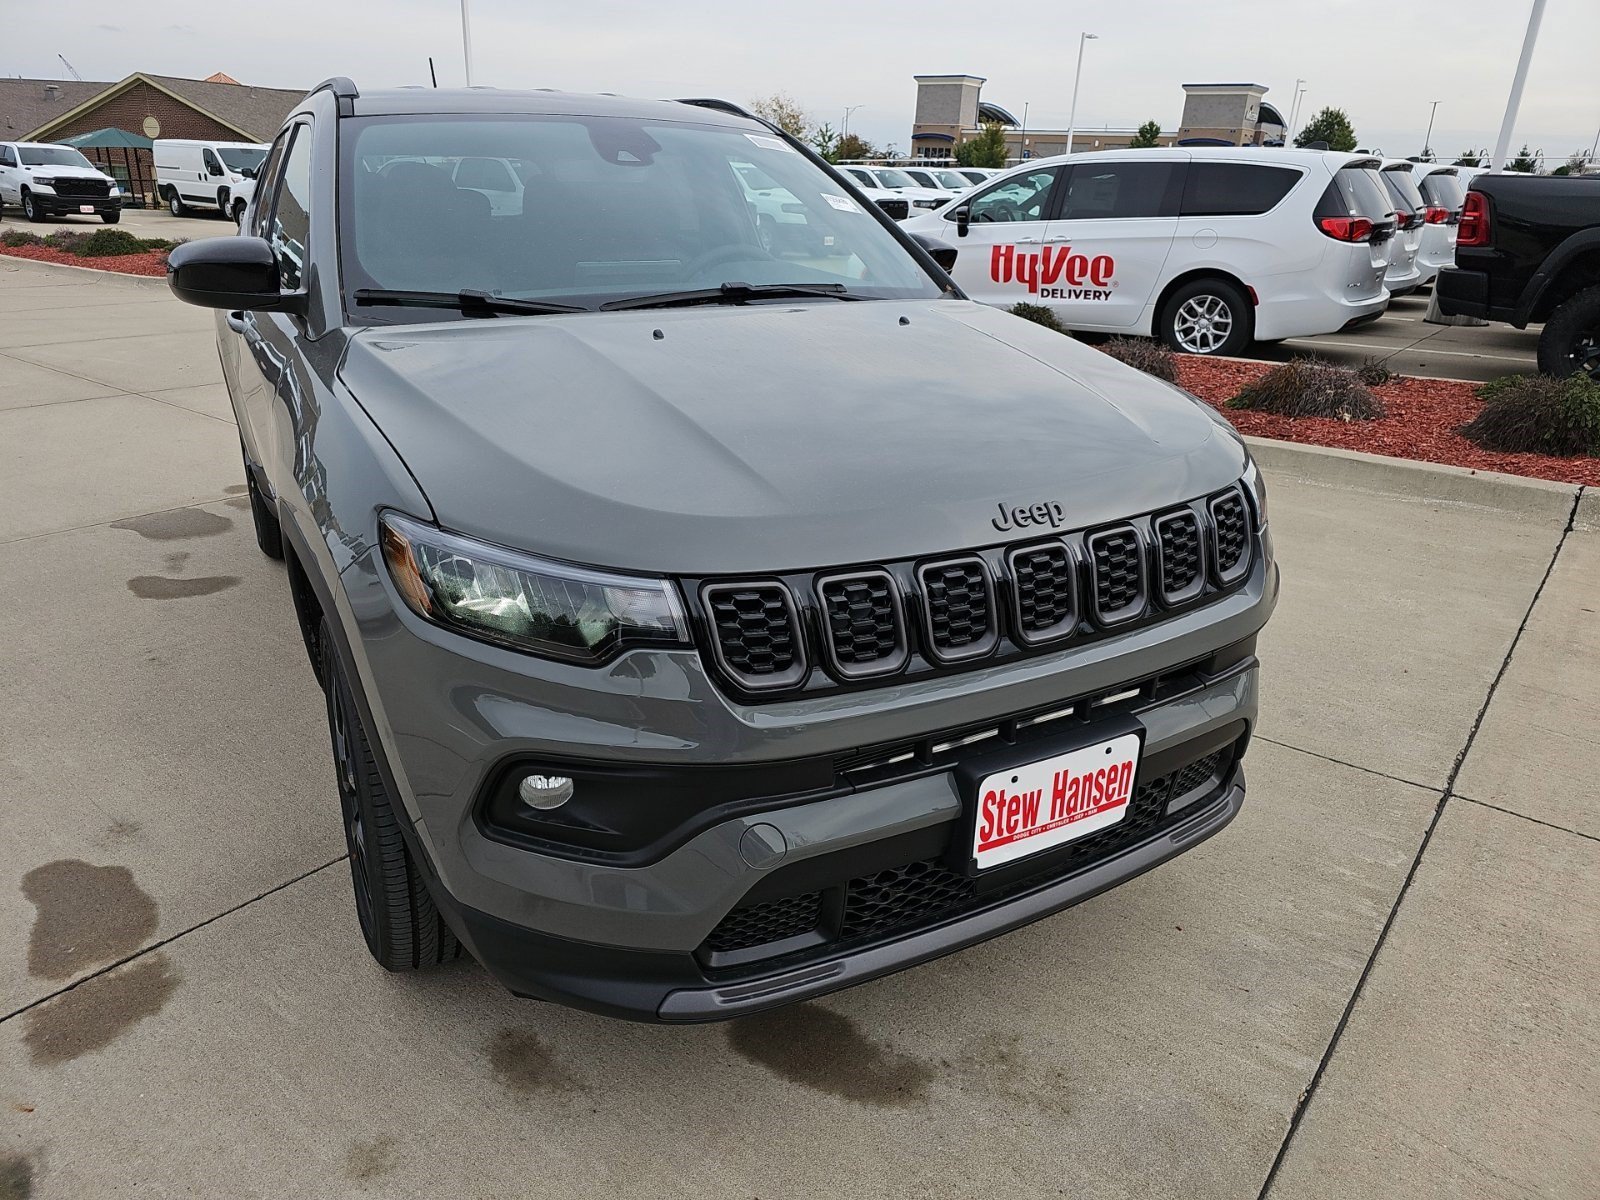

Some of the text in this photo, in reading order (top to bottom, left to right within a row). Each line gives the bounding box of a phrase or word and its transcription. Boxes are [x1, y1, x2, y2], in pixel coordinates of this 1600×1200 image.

[1041, 288, 1112, 301] DELIVERY
[991, 500, 1066, 532] Jeep
[979, 760, 1133, 842] Stew Hansen
